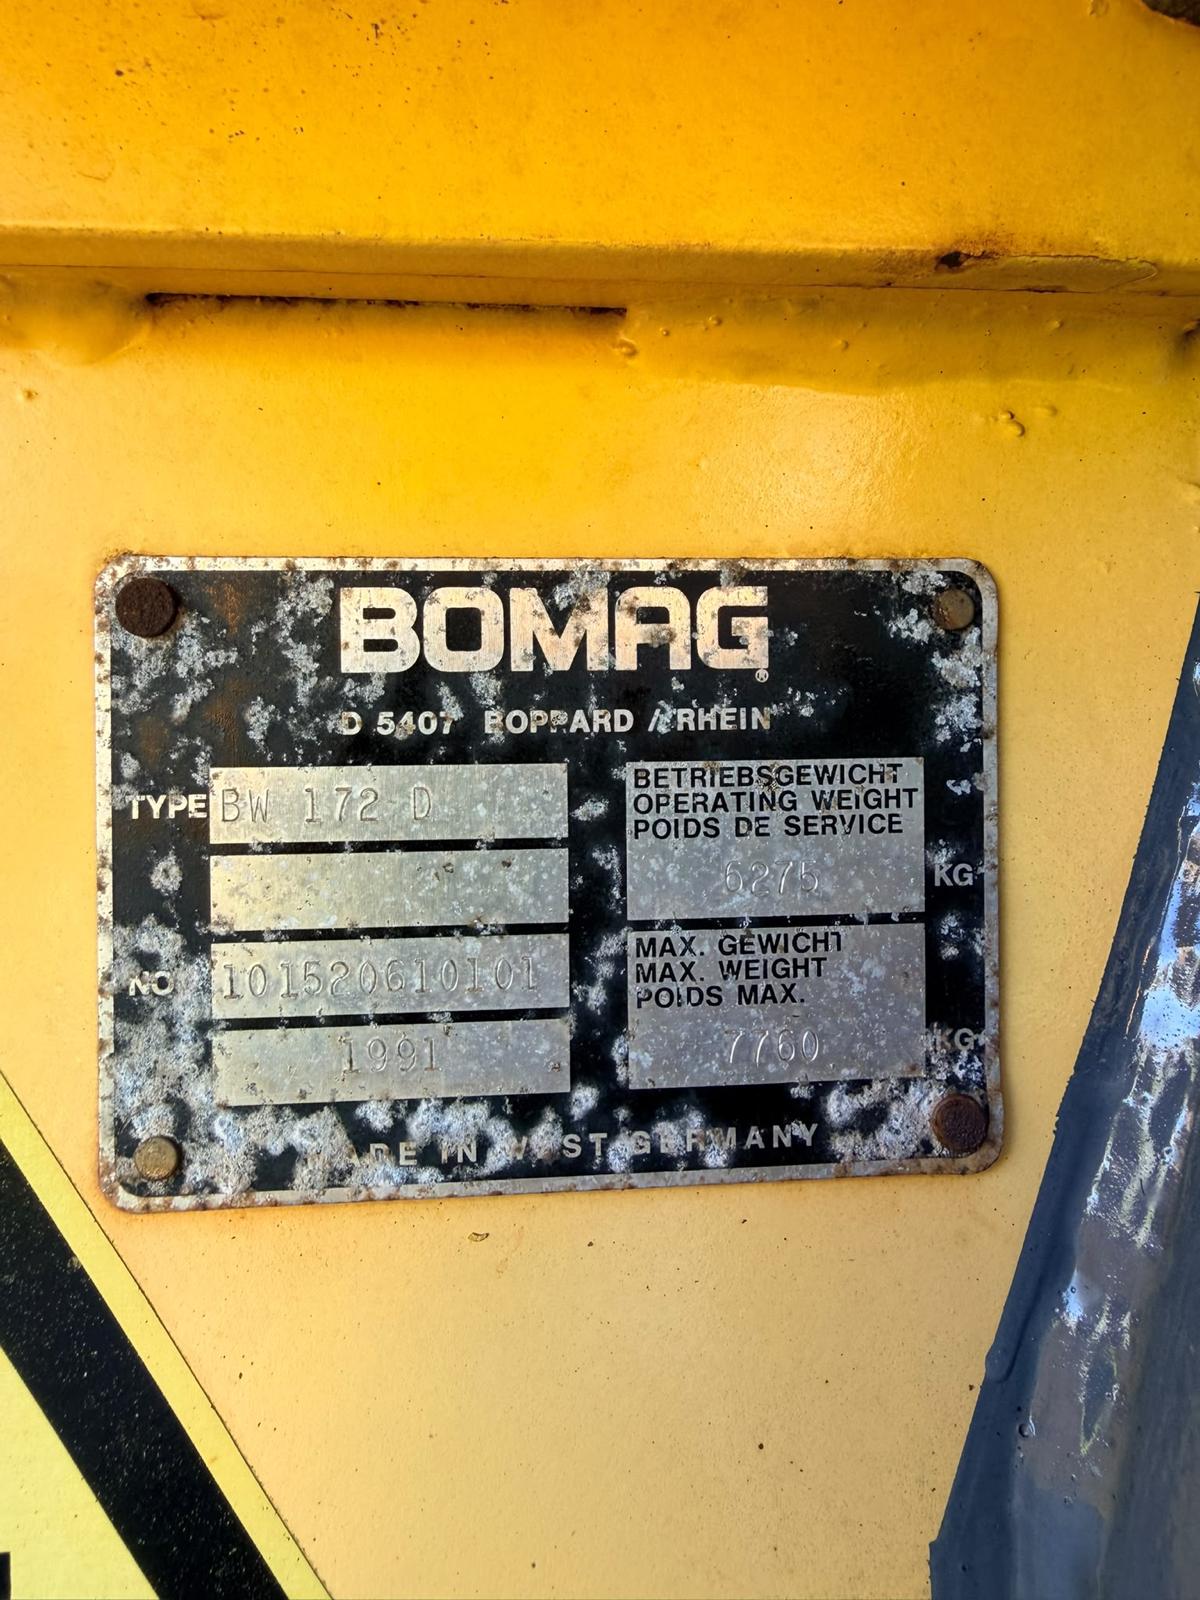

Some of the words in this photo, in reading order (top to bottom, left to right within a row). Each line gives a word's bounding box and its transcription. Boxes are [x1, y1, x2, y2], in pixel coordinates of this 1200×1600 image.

[338, 584, 769, 675] BOMAG
[340, 710, 363, 736] D
[376, 710, 455, 735] 5407
[484, 708, 634, 734] BOPPARD
[633, 763, 903, 789] BETRIEBSGEWICHT
[128, 793, 208, 821] TYPE
[221, 787, 269, 823] BW
[304, 786, 378, 824] 172
[411, 785, 432, 821] D
[632, 791, 798, 815] OPERATING
[810, 787, 919, 811] WEIGHT
[633, 817, 720, 840] POIDS
[734, 815, 771, 838] DE
[783, 813, 904, 837] SERVICE
[723, 859, 819, 897] 6275
[934, 863, 974, 887] KG
[634, 935, 705, 959] MAX.
[128, 970, 175, 996] NO
[223, 955, 538, 999] 101520610101
[635, 960, 705, 984] MAX.
[718, 956, 828, 982] WEIGHT
[636, 985, 724, 1009] POIDS
[737, 982, 806, 1006] MAX.
[724, 1028, 820, 1067] 7760
[934, 1027, 976, 1051] KG
[342, 1036, 443, 1074] 1991
[441, 1139, 478, 1164] IN
[507, 1133, 608, 1161] WST
